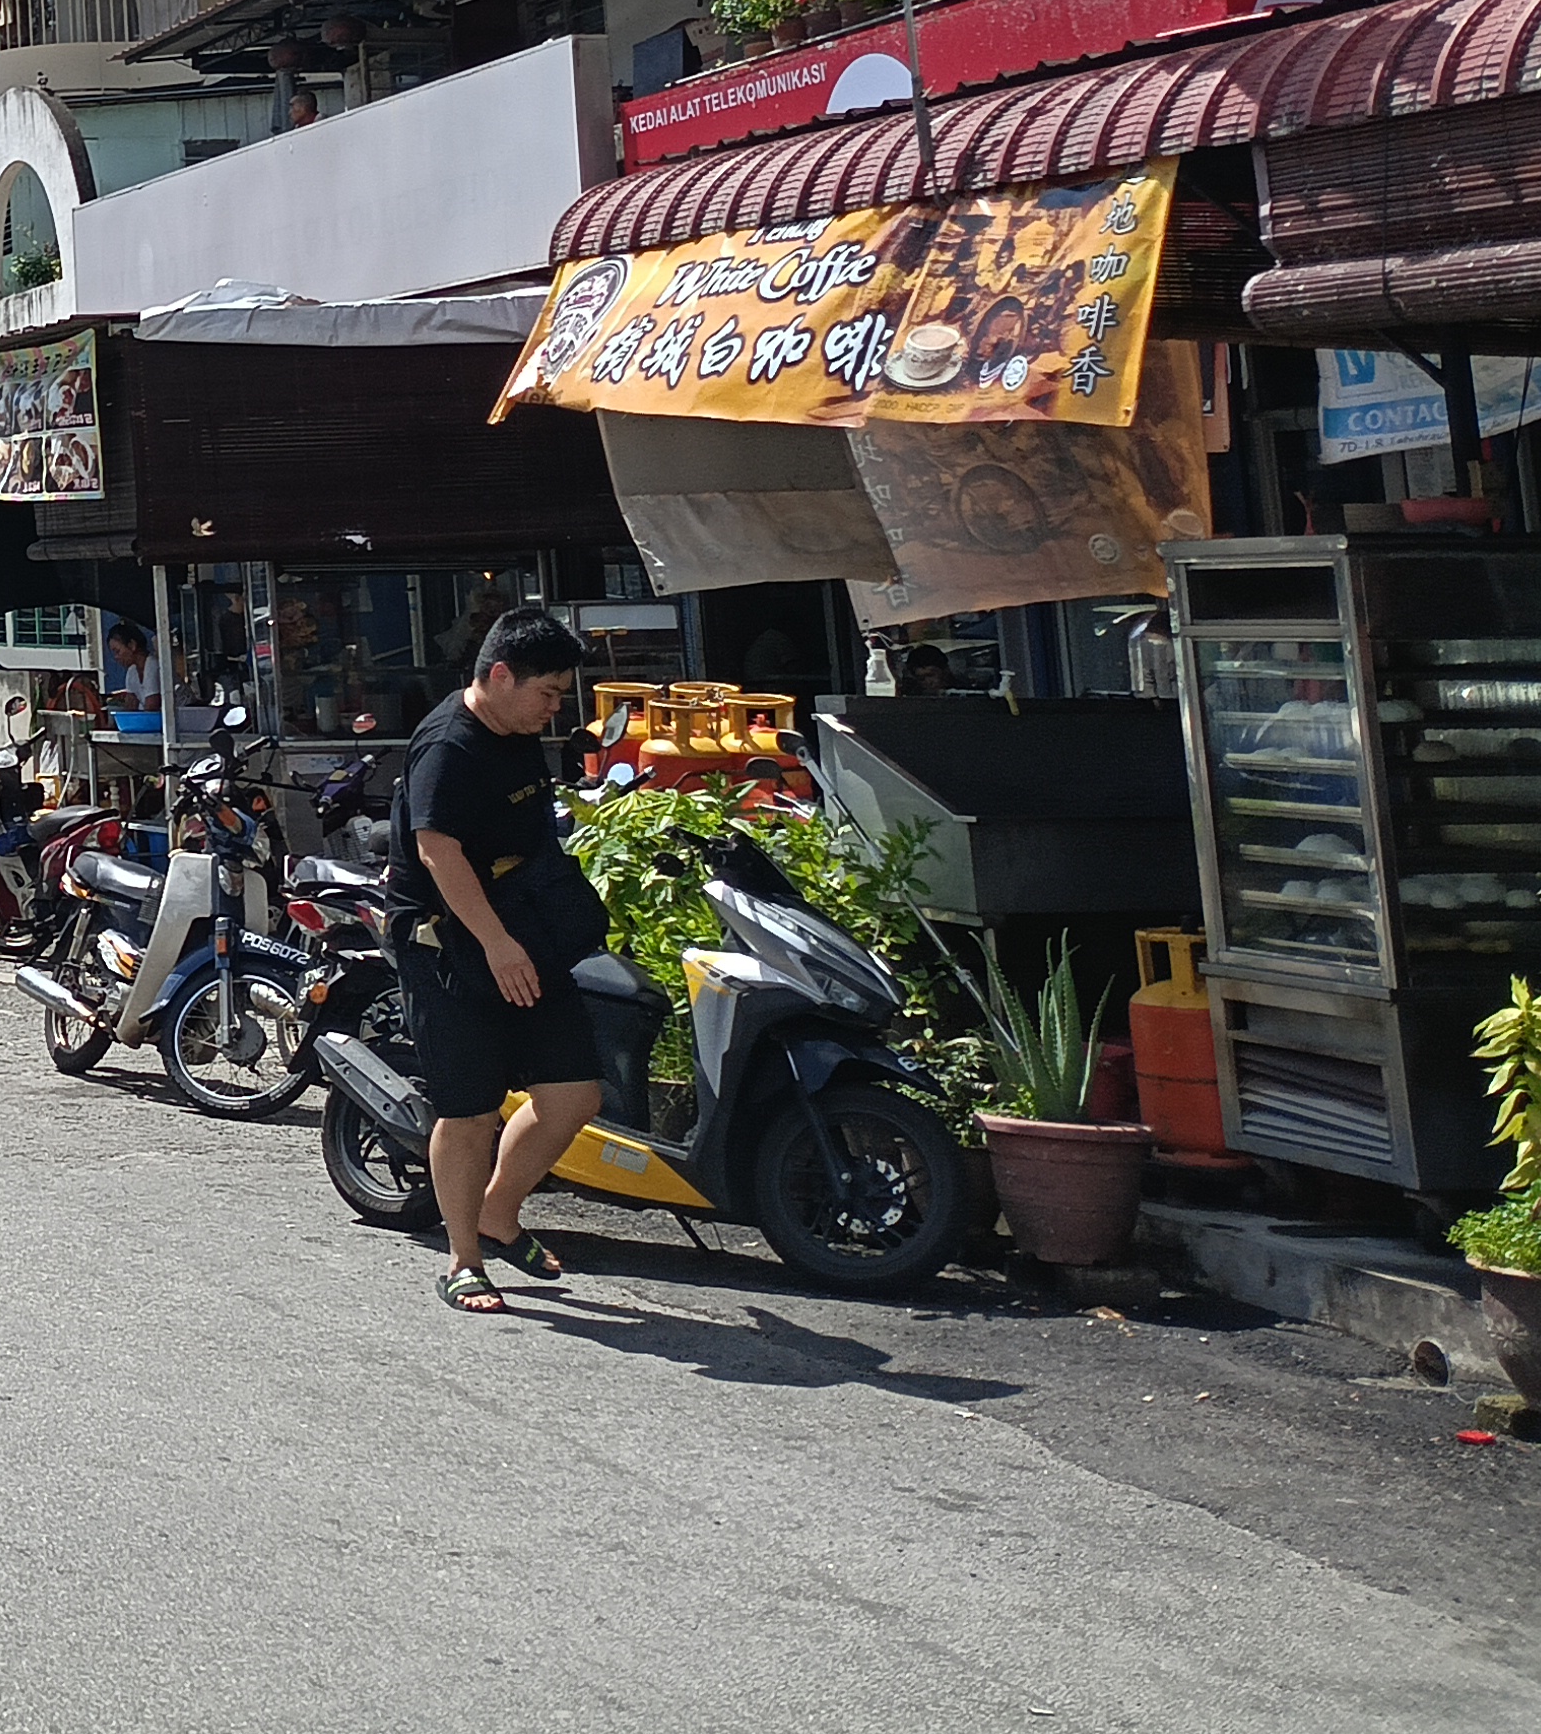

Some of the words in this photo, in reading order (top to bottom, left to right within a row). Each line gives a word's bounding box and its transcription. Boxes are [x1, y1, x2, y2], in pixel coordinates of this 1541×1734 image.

[629, 110, 667, 134] KEDAI
[669, 98, 701, 124] ALAT
[704, 63, 826, 114] TELEKOMUNIKASI
[657, 256, 761, 307] White
[759, 242, 878, 304] Coffee
[1062, 177, 1147, 396] 地咖啡香
